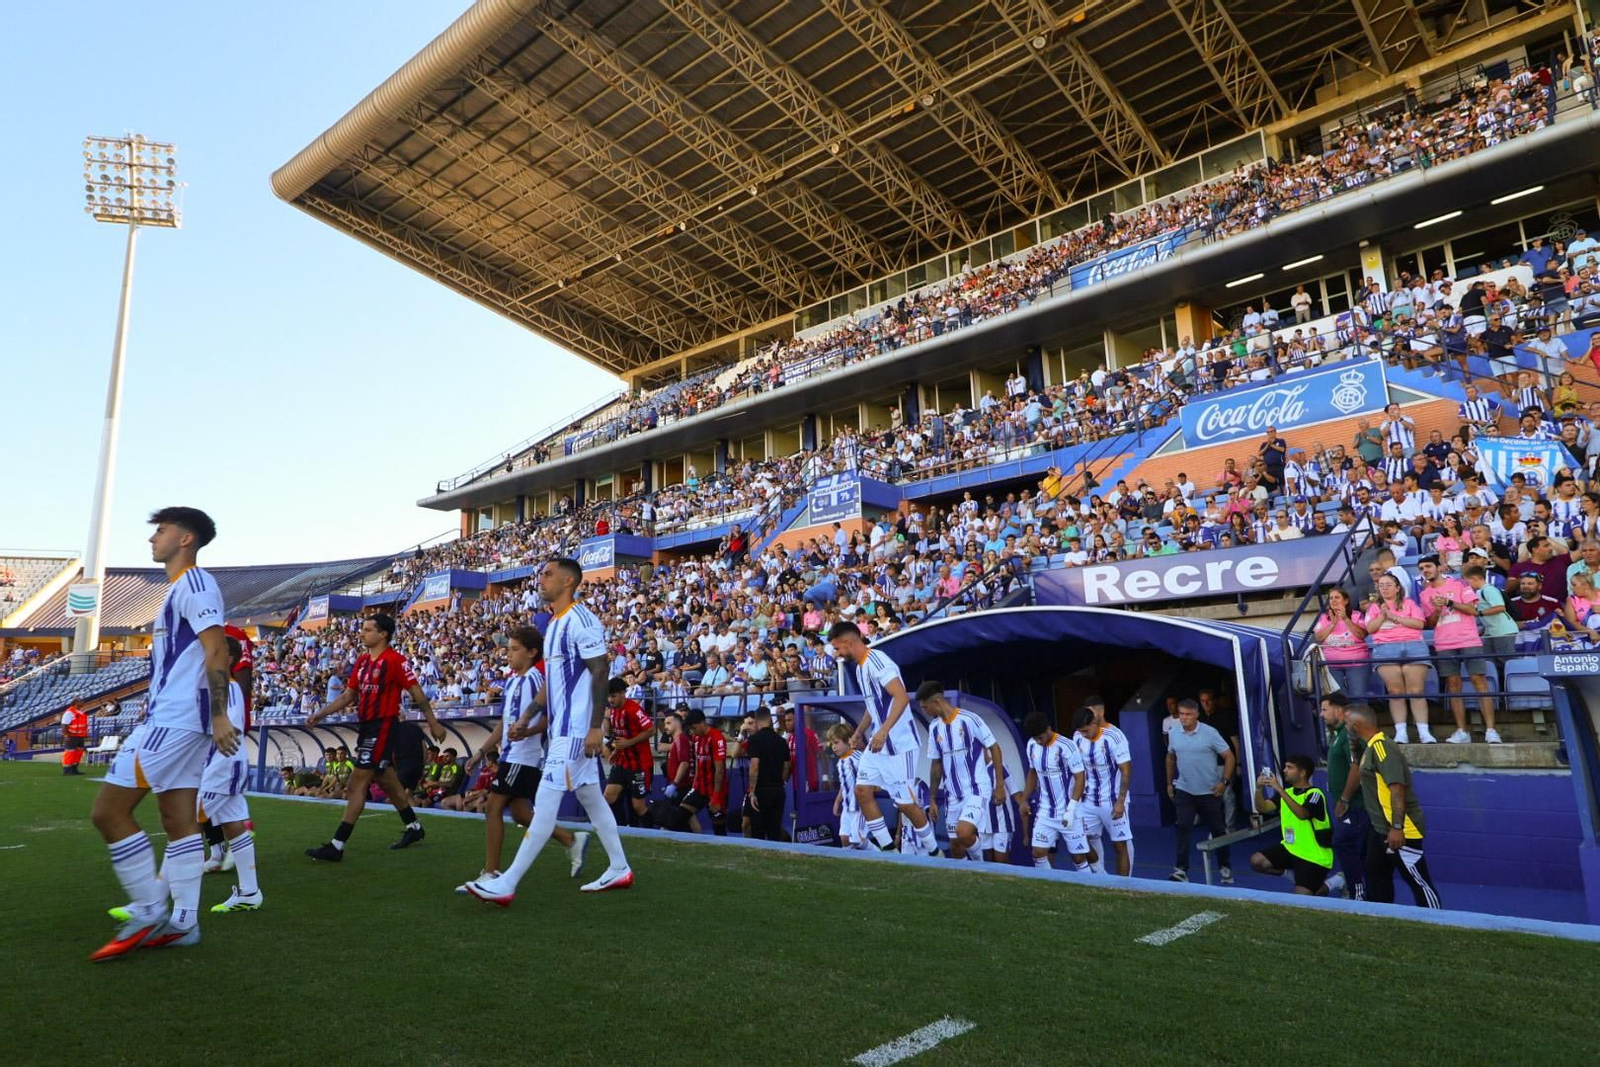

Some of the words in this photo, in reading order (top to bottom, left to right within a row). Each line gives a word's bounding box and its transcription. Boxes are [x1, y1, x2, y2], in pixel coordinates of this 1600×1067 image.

[1196, 383, 1310, 440] Coca-Cola
[582, 545, 612, 567] Coca-Cola
[1082, 556, 1279, 604] Recre
[1554, 654, 1599, 664] Antonio
